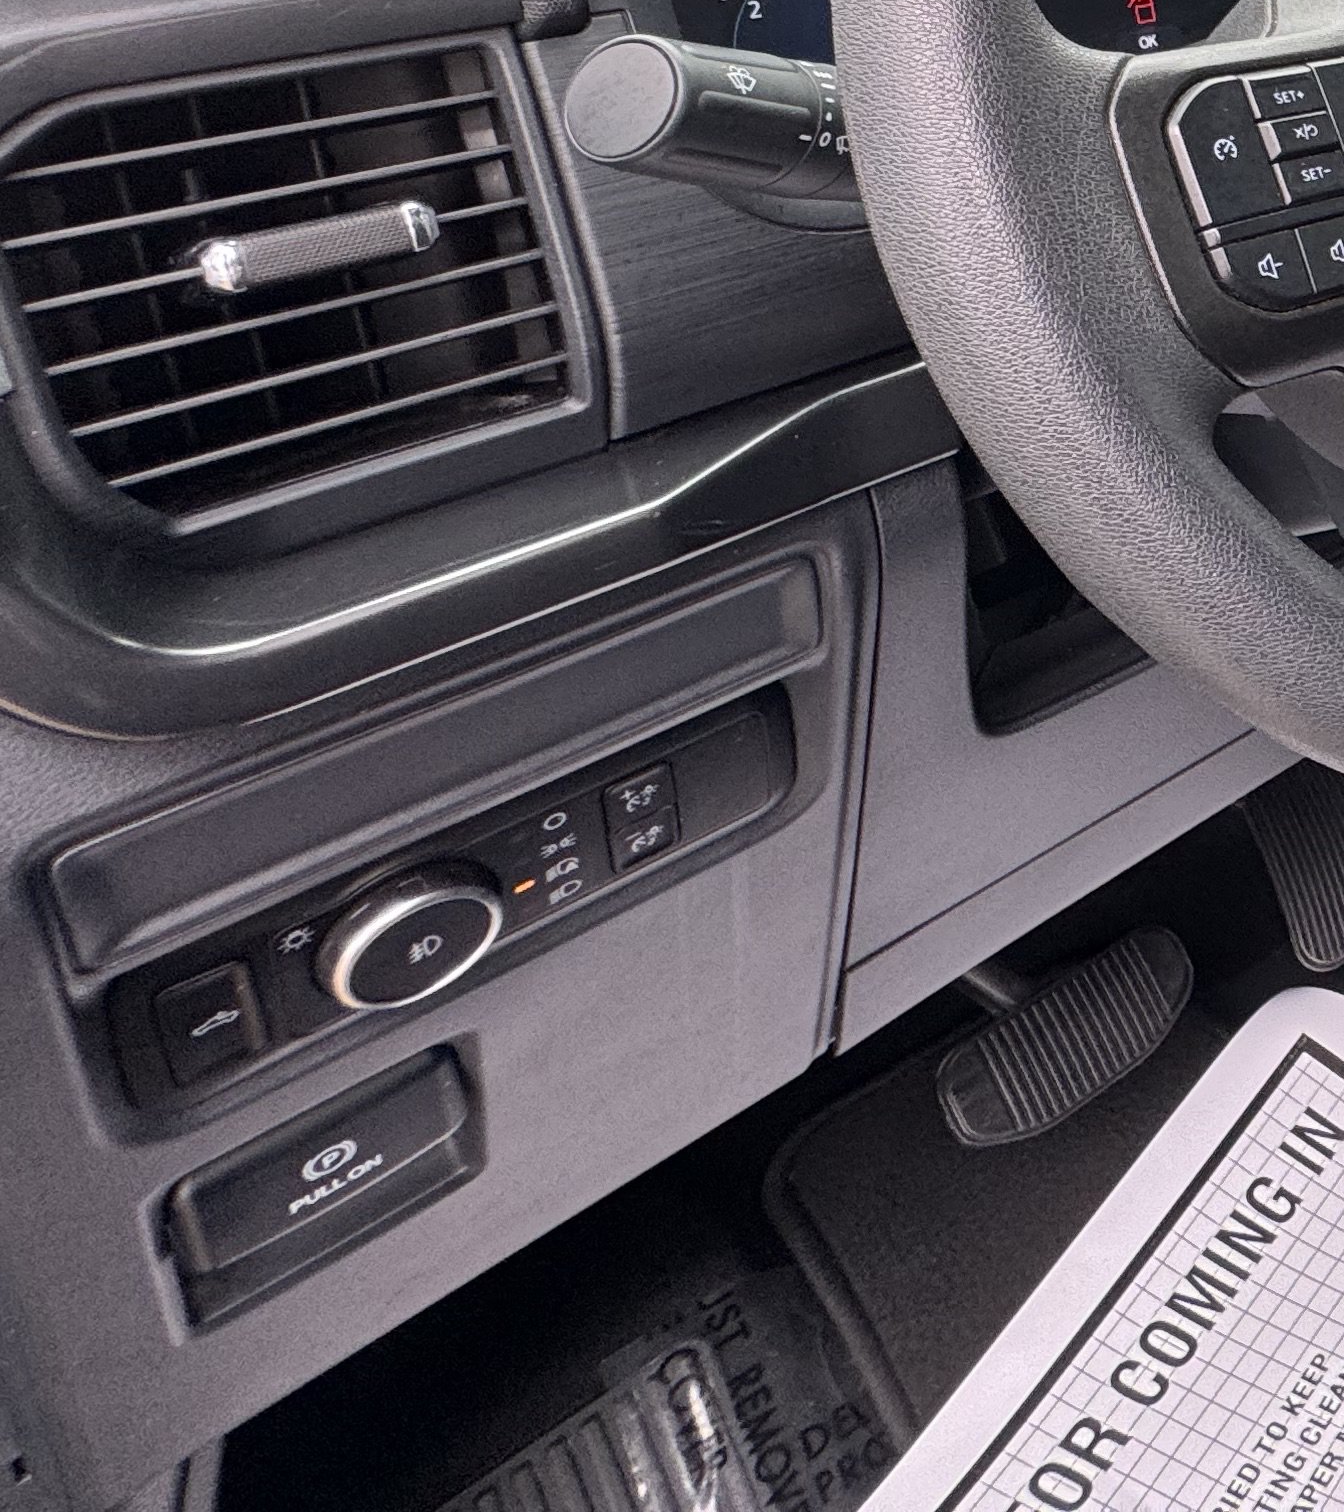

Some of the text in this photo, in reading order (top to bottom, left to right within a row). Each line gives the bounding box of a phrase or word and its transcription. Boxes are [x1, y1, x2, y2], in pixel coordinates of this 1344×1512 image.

[747, 0, 762, 20] 2
[1138, 34, 1159, 49] OK
[290, 1153, 384, 1216] PULL ON
[1006, 1415, 1134, 1512] OR
[1110, 1176, 1304, 1407] COMING
[1212, 1352, 1329, 1512] IED TO KEEP
